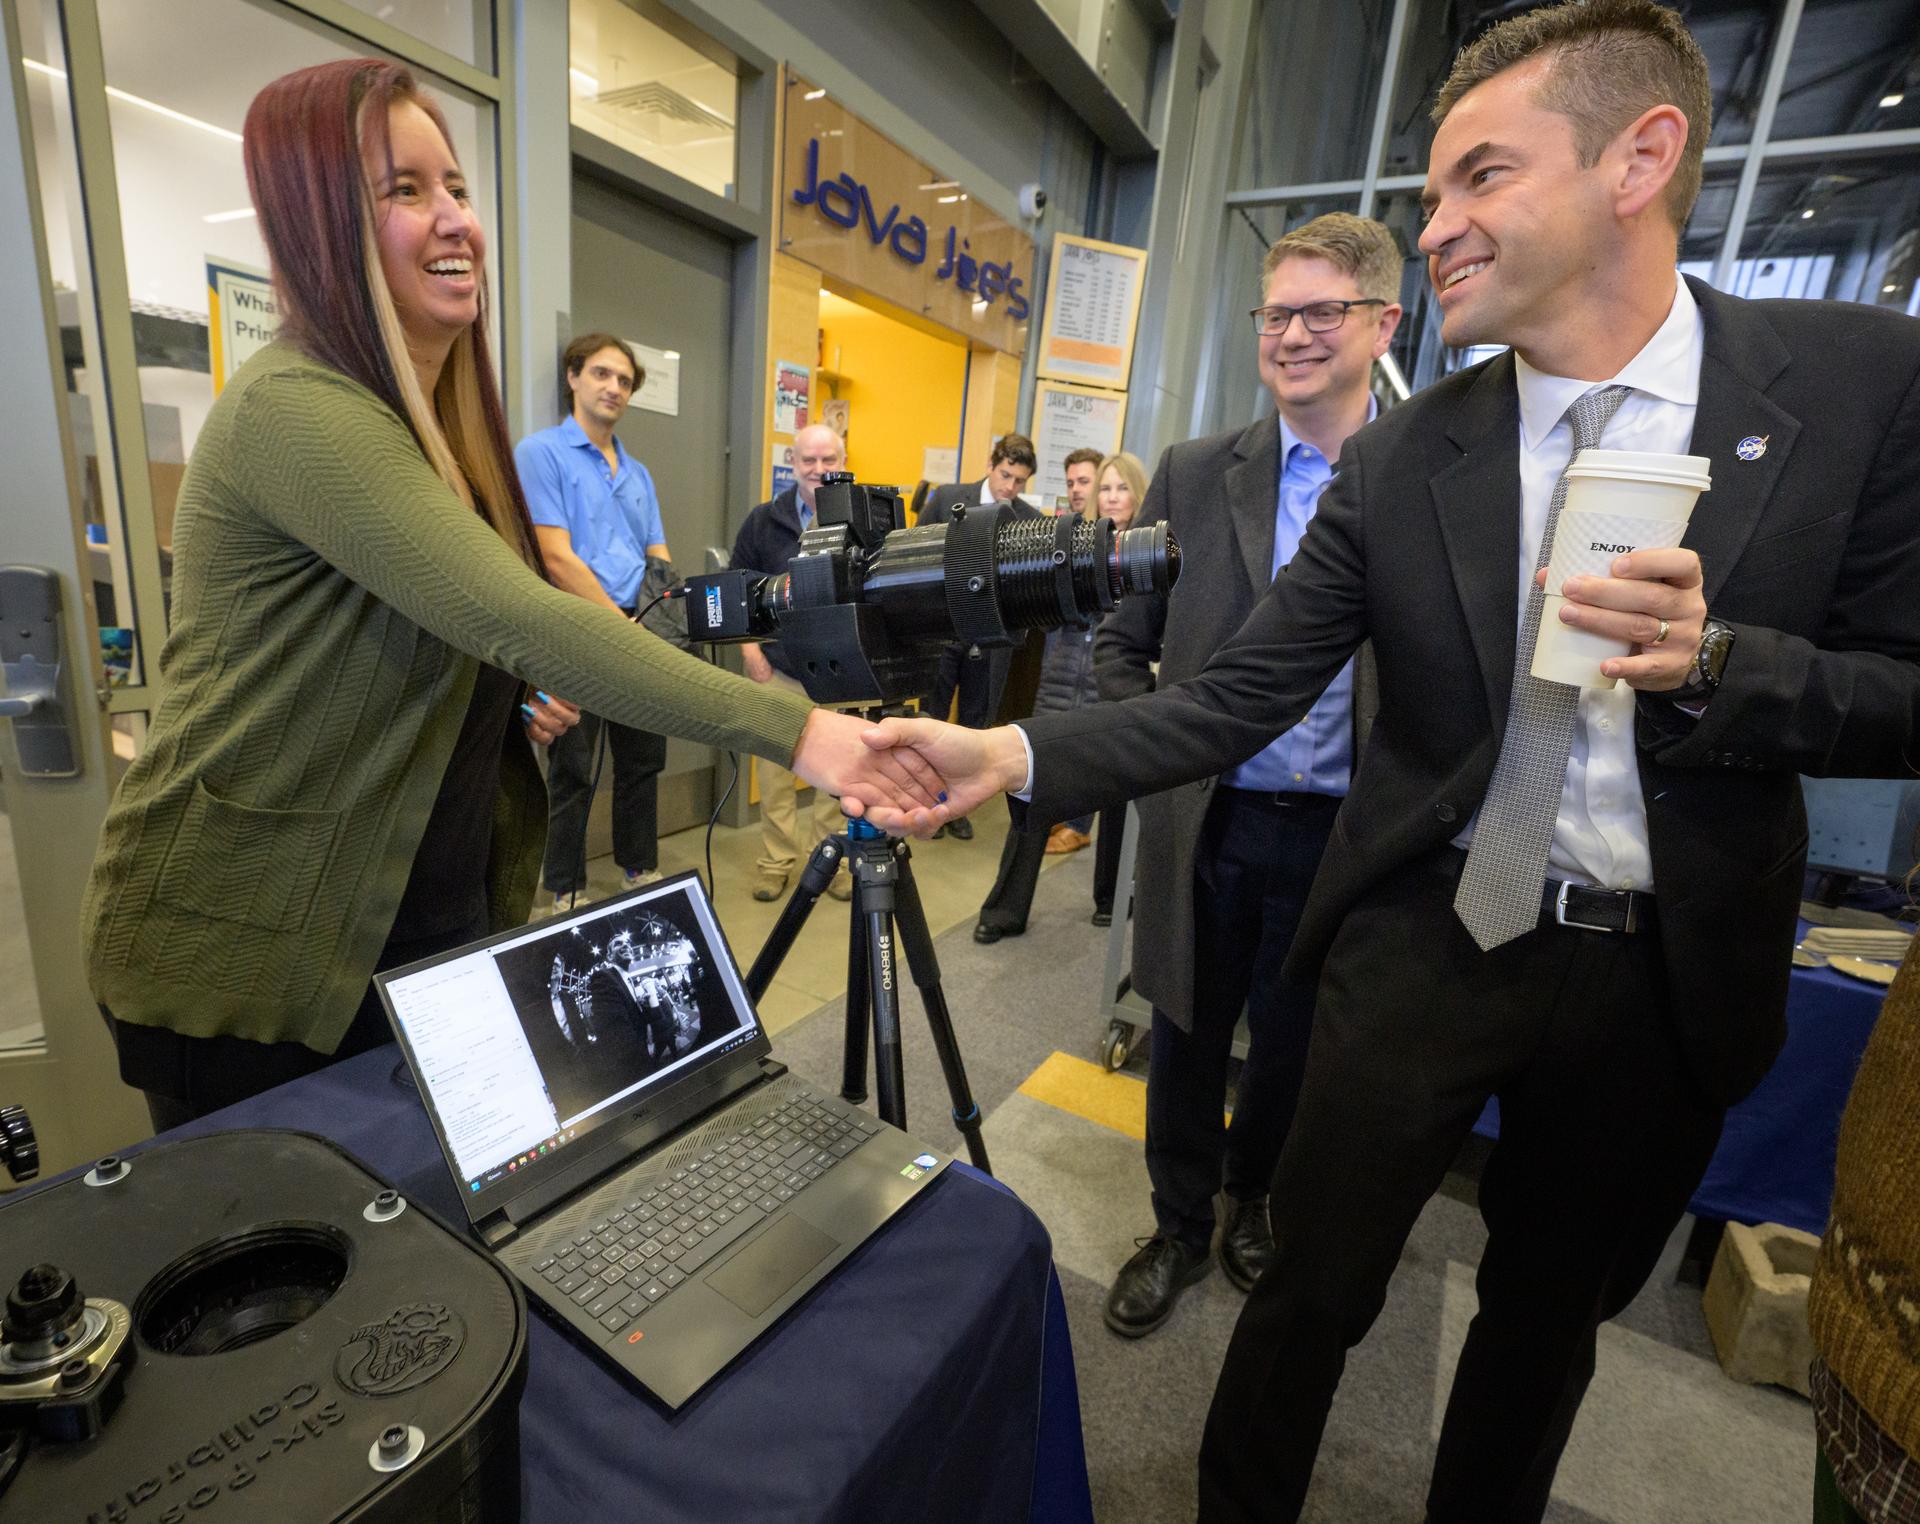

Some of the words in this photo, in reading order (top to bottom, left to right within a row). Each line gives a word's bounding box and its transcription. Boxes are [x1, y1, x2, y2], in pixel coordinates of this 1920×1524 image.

[794, 138, 928, 265] Java
[1590, 542, 1636, 554] ENJOY
[880, 950, 893, 991] BENRO
